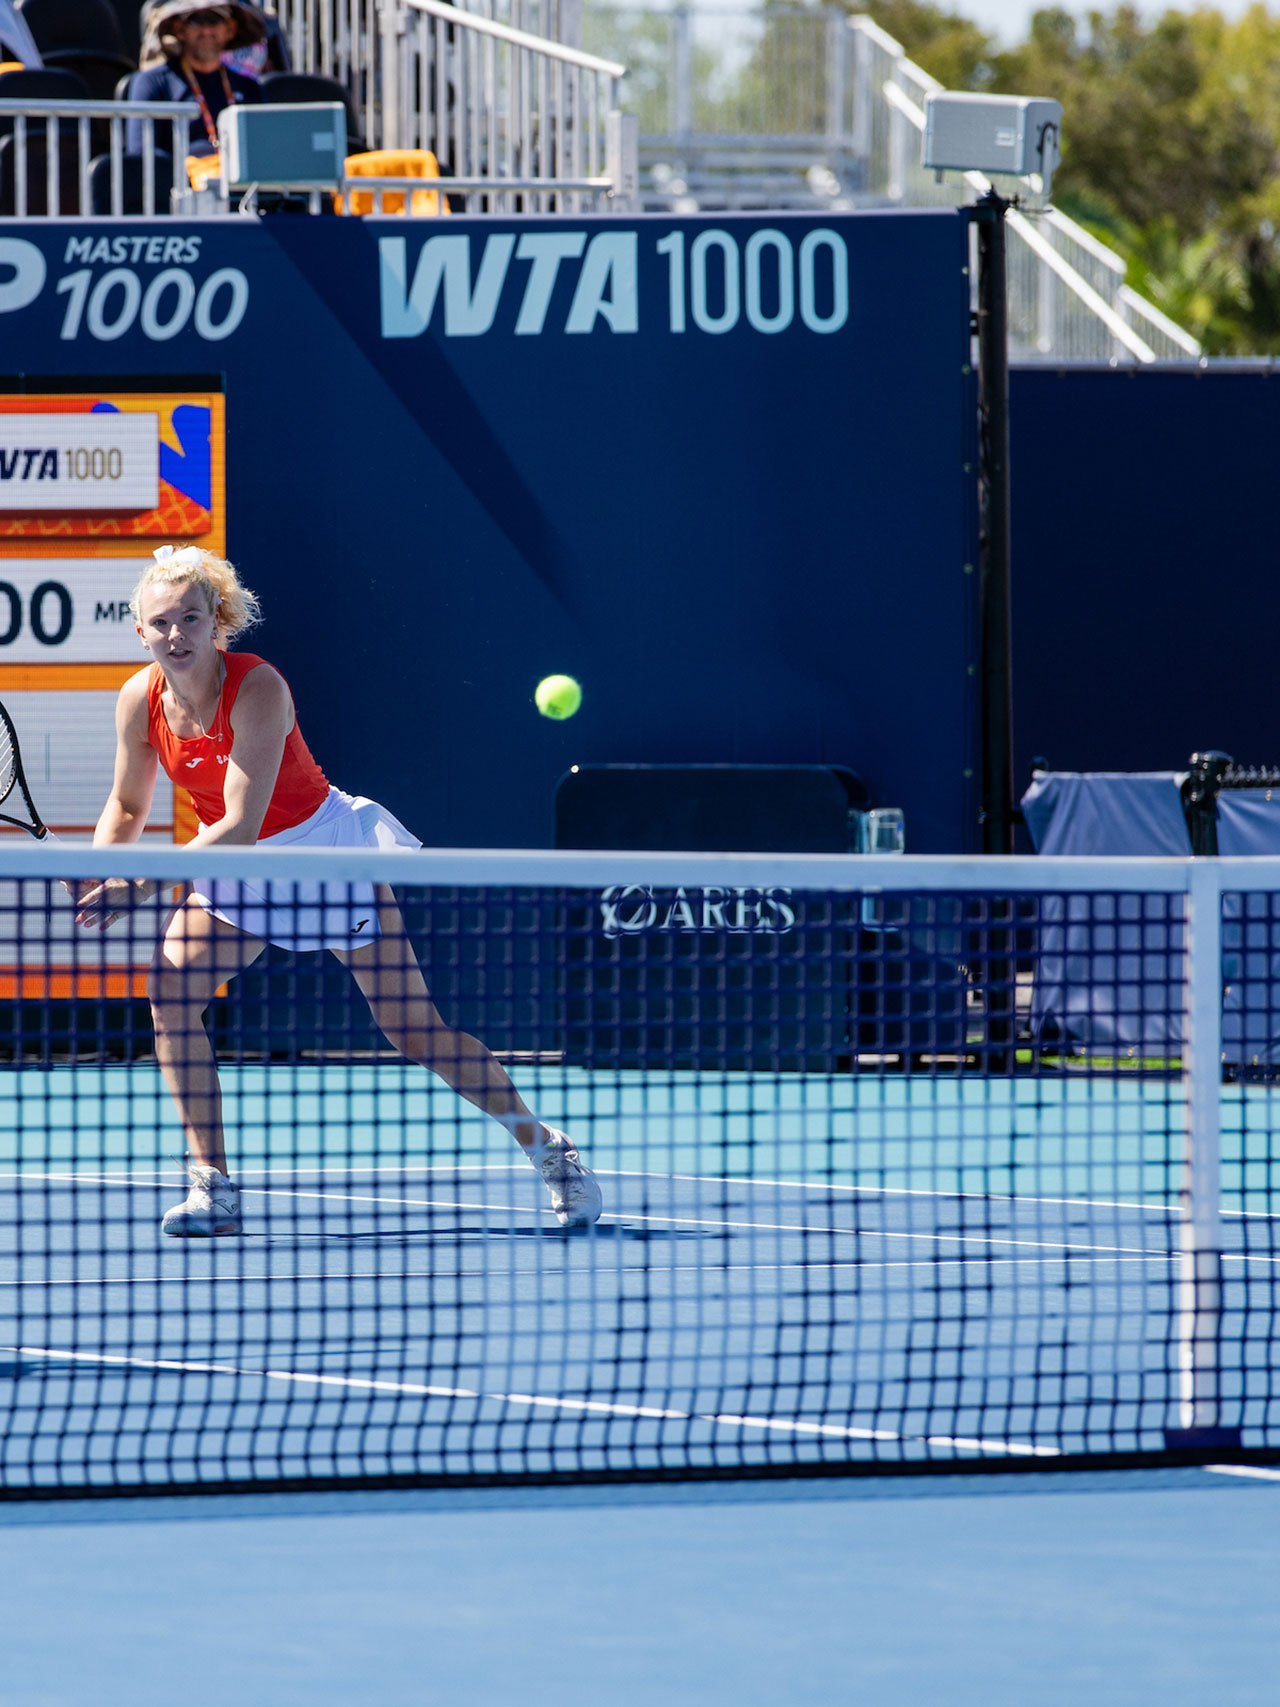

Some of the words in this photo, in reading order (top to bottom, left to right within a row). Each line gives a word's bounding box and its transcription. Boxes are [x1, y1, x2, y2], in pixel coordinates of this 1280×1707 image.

[64, 236, 202, 264] MASTERS
[379, 231, 639, 338] WTA
[656, 228, 850, 335] 1000
[56, 267, 250, 342] 1000
[65, 448, 123, 480] 1000
[94, 601, 137, 623] MP
[659, 886, 795, 935] ARES
